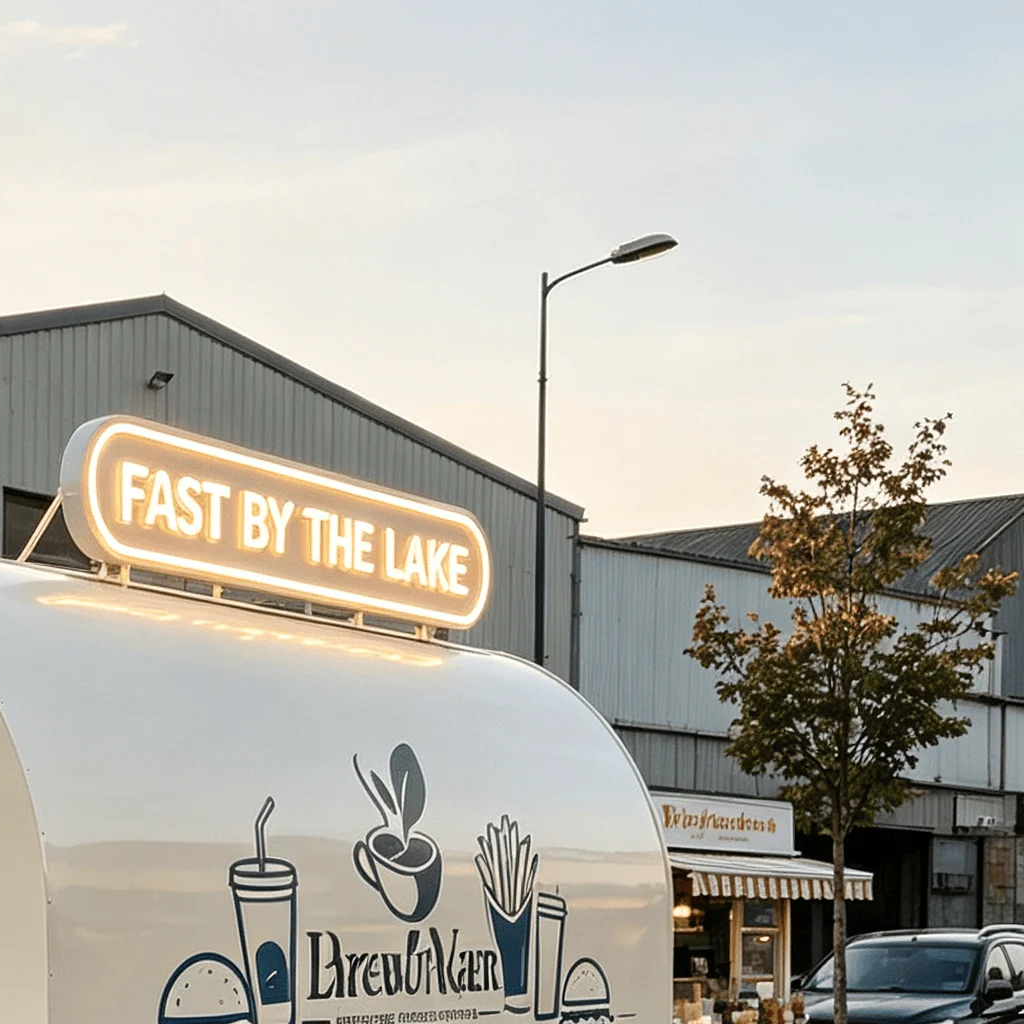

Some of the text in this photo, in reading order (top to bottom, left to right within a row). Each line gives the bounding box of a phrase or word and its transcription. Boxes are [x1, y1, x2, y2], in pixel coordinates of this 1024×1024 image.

[117, 461, 470, 596] FAST BY THE LAKE
